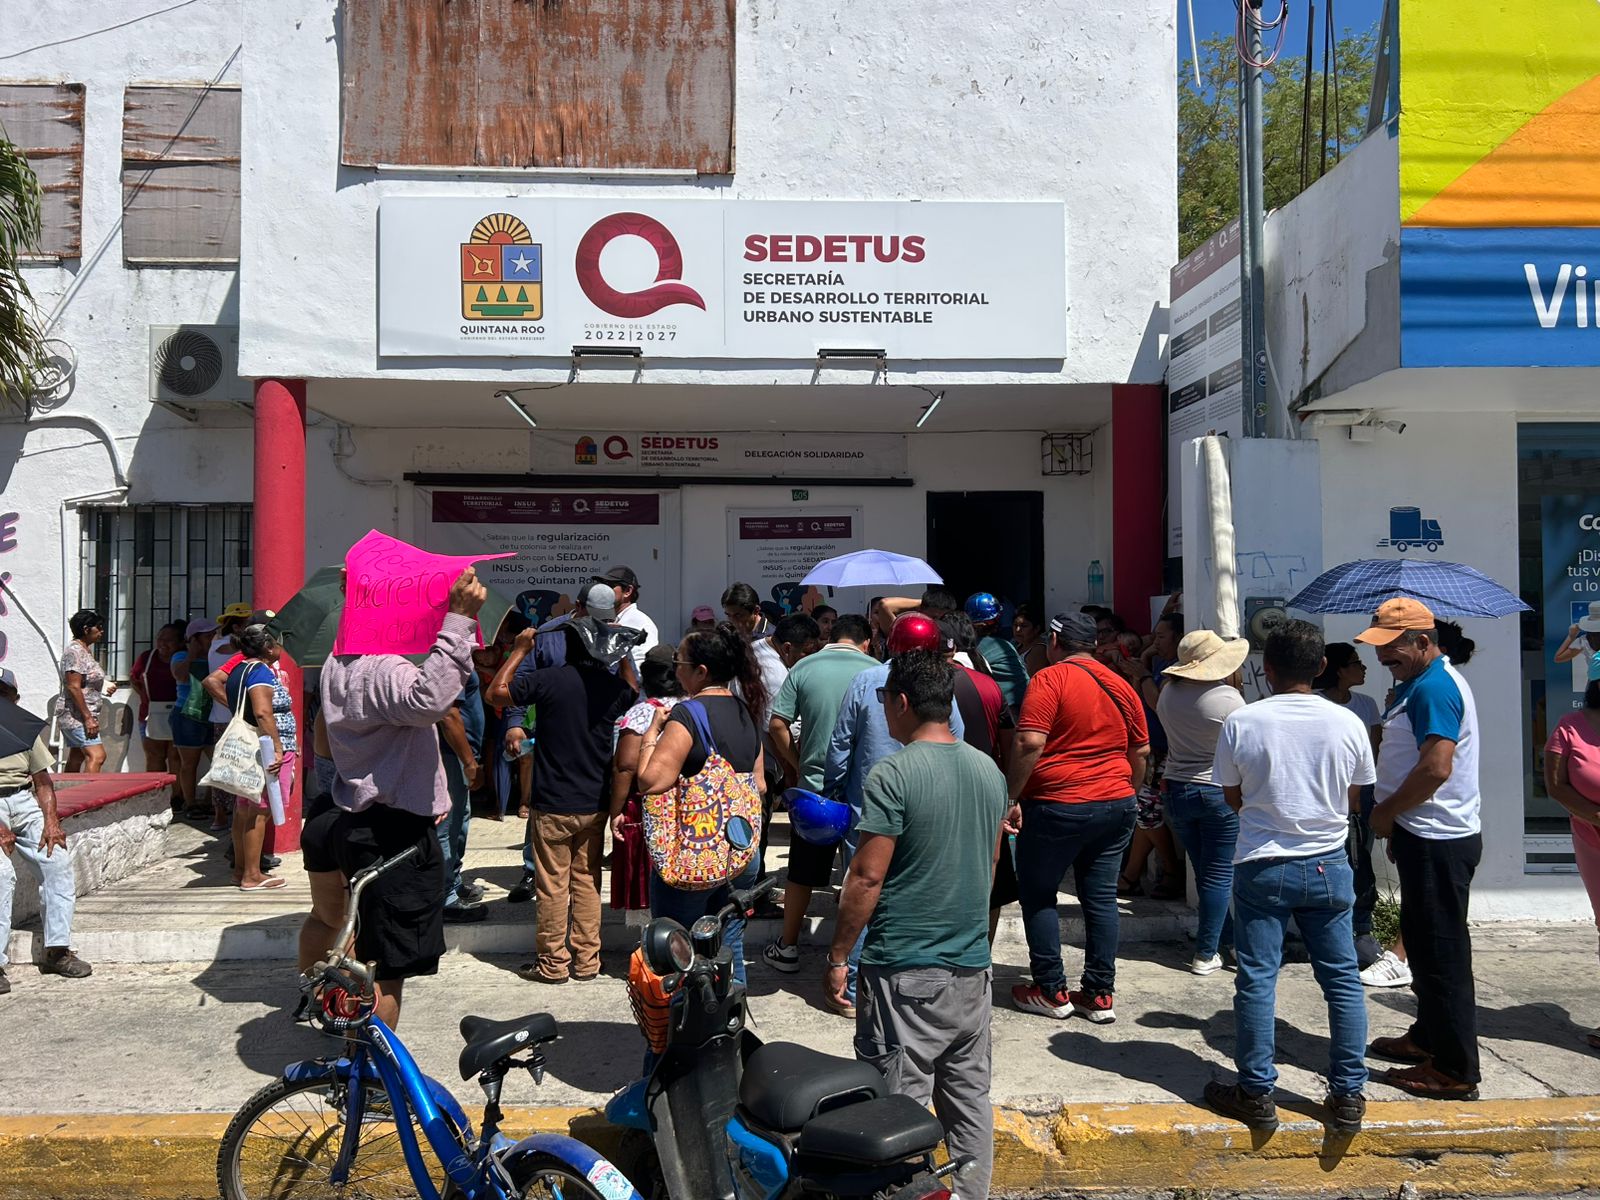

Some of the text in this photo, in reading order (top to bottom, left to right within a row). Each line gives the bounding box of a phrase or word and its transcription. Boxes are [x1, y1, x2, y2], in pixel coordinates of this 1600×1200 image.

[743, 234, 926, 263] SEDETUS
[743, 270, 844, 286] SECRETARÍA
[744, 291, 989, 305] DE DESARROLLO TERRITORIAL
[744, 311, 932, 324] URBANO SUSTENTABLE
[460, 326, 545, 335] QUINTANA ROO
[641, 437, 719, 449] SEDETUS
[745, 450, 802, 458] DELEGACIÓN
[536, 533, 610, 542] regularización
[540, 564, 587, 573] Gobierno
[1567, 565, 1590, 577] tus
[527, 576, 575, 585] Quintana
[579, 576, 594, 584] Ro
[1573, 582, 1583, 592] a
[220, 752, 240, 763] ROMA
